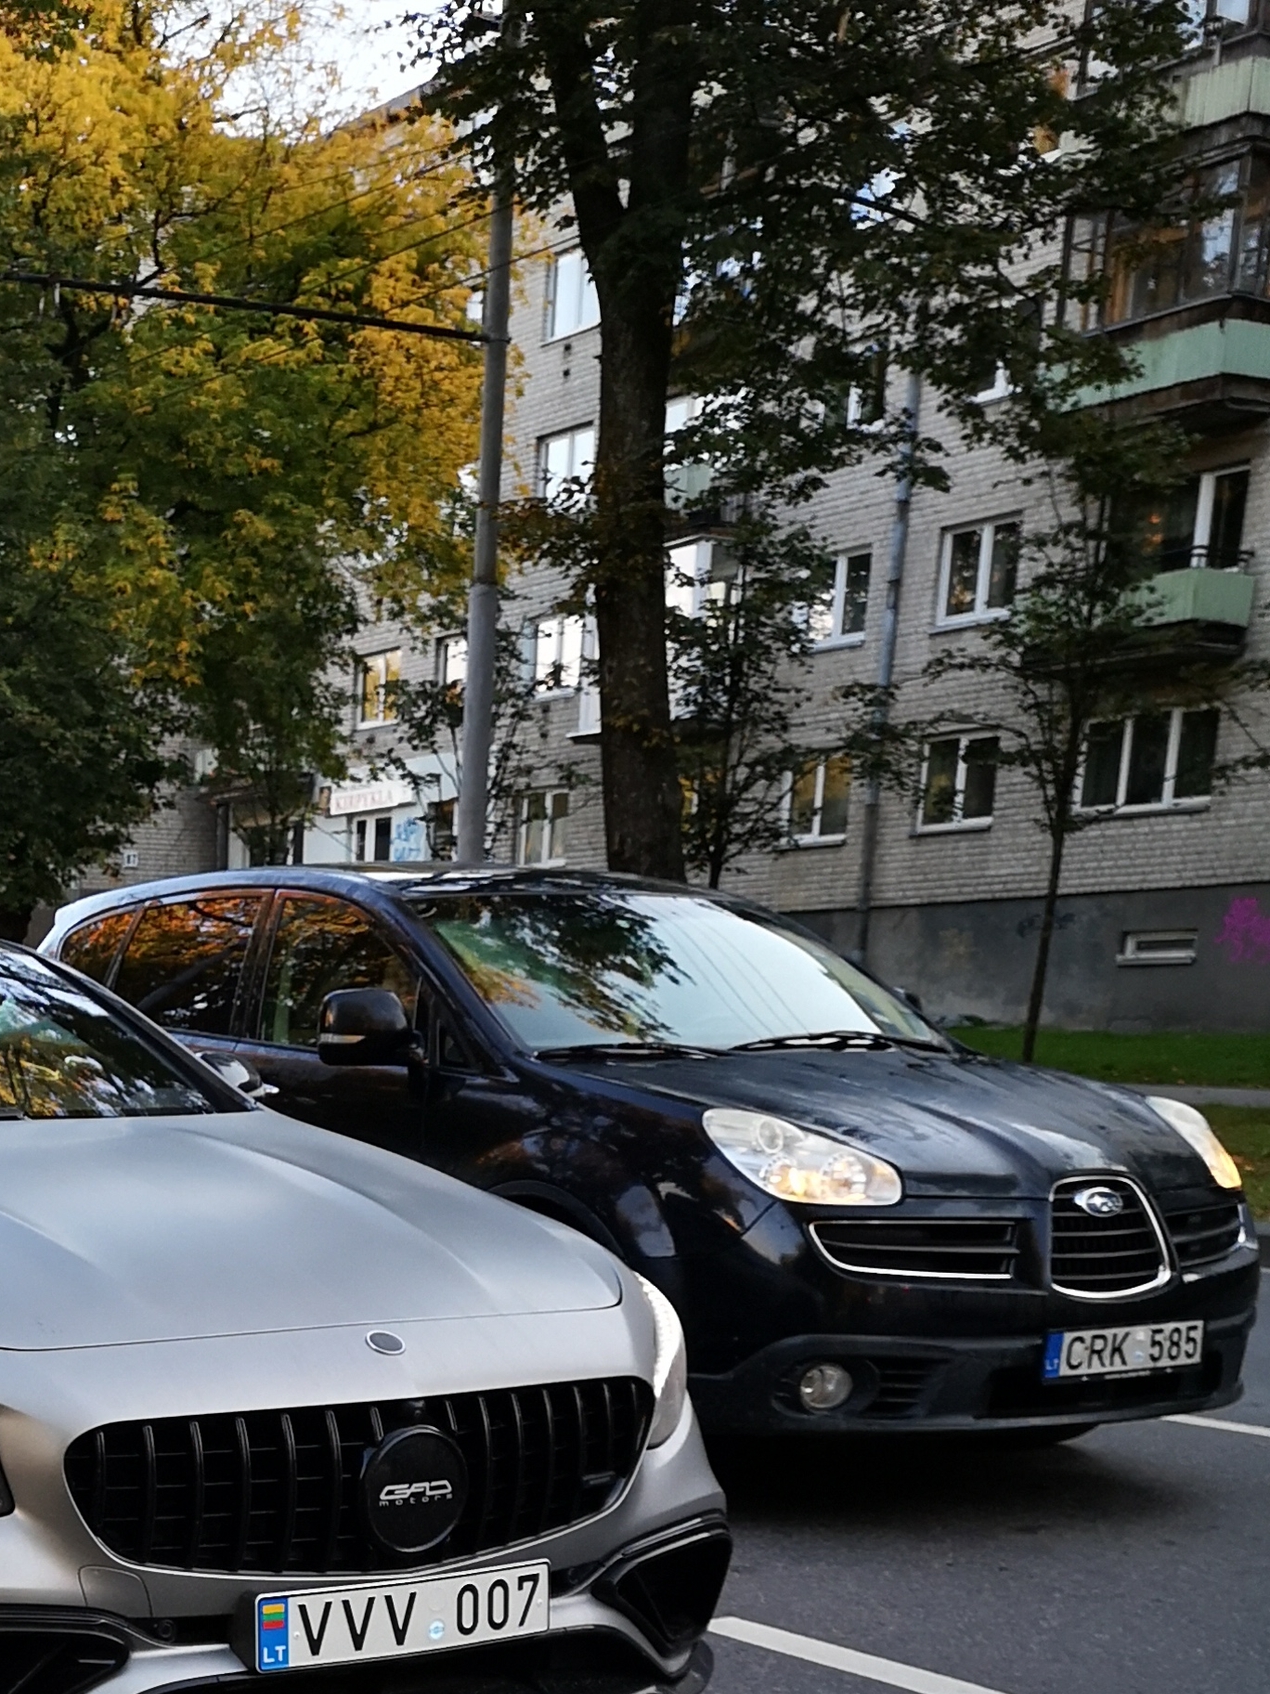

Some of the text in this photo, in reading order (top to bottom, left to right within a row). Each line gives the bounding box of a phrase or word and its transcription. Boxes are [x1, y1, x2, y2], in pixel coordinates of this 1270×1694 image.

[1066, 1325, 1198, 1370] CRK 585
[298, 1573, 540, 1656] VVV 007
[263, 1645, 286, 1663] LT
